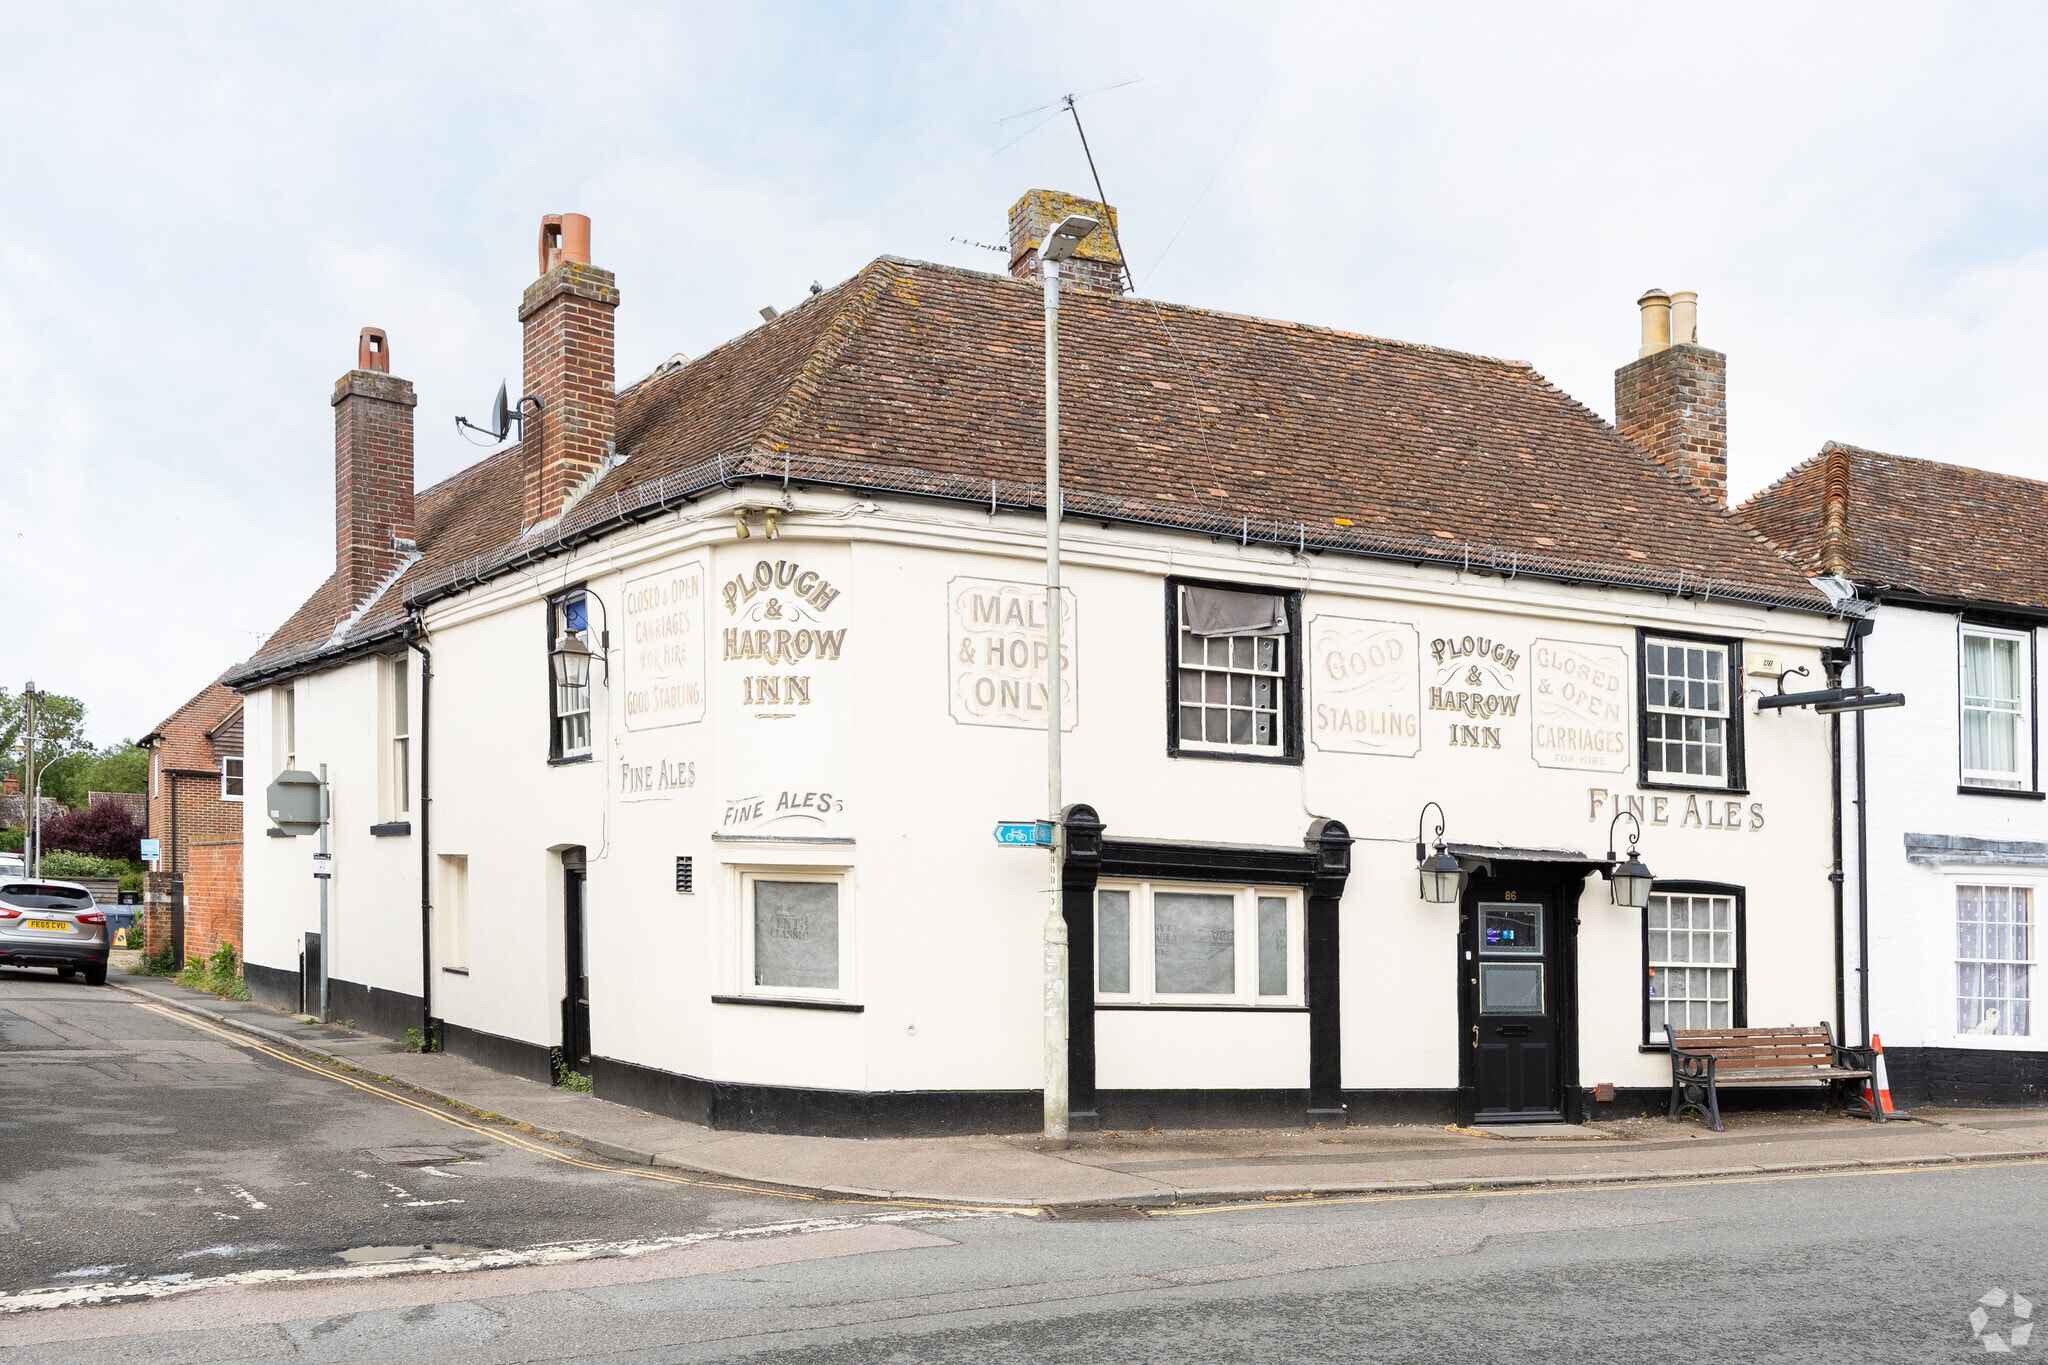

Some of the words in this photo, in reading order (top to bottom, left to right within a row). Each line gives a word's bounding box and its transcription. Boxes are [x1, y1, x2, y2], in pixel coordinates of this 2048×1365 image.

[628, 586, 660, 615] CLOSED
[672, 575, 699, 603] OPEN
[722, 559, 841, 615] PLOUGH
[764, 597, 783, 621] &
[973, 594, 1048, 628] MAL
[636, 610, 690, 644] CARRIAGES
[664, 643, 687, 668] HIRE
[722, 627, 848, 666] HARROW
[959, 637, 976, 664] &
[1325, 638, 1404, 682] GOOD
[1430, 635, 1521, 671] PLOUGH
[1465, 664, 1483, 687] &
[1536, 647, 1620, 692] CLOSED
[628, 690, 649, 715] GOOD
[743, 676, 811, 705] INN
[1428, 686, 1521, 719] HARROW
[1538, 678, 1554, 695] &
[1562, 682, 1620, 723] OPEN
[1317, 703, 1417, 738] STABLING
[1449, 723, 1502, 749] INN
[1536, 724, 1625, 754] CARRIAGES
[621, 762, 653, 793] FINE
[657, 759, 696, 790] ALES
[1555, 754, 1575, 763] FOR
[1580, 756, 1606, 766] HIRE
[724, 800, 765, 826] FINE
[776, 791, 834, 813] ALES
[1588, 787, 1670, 826] FINE
[1680, 794, 1765, 832] ALES
[1505, 890, 1517, 901] 86
[31, 921, 50, 929] FE65
